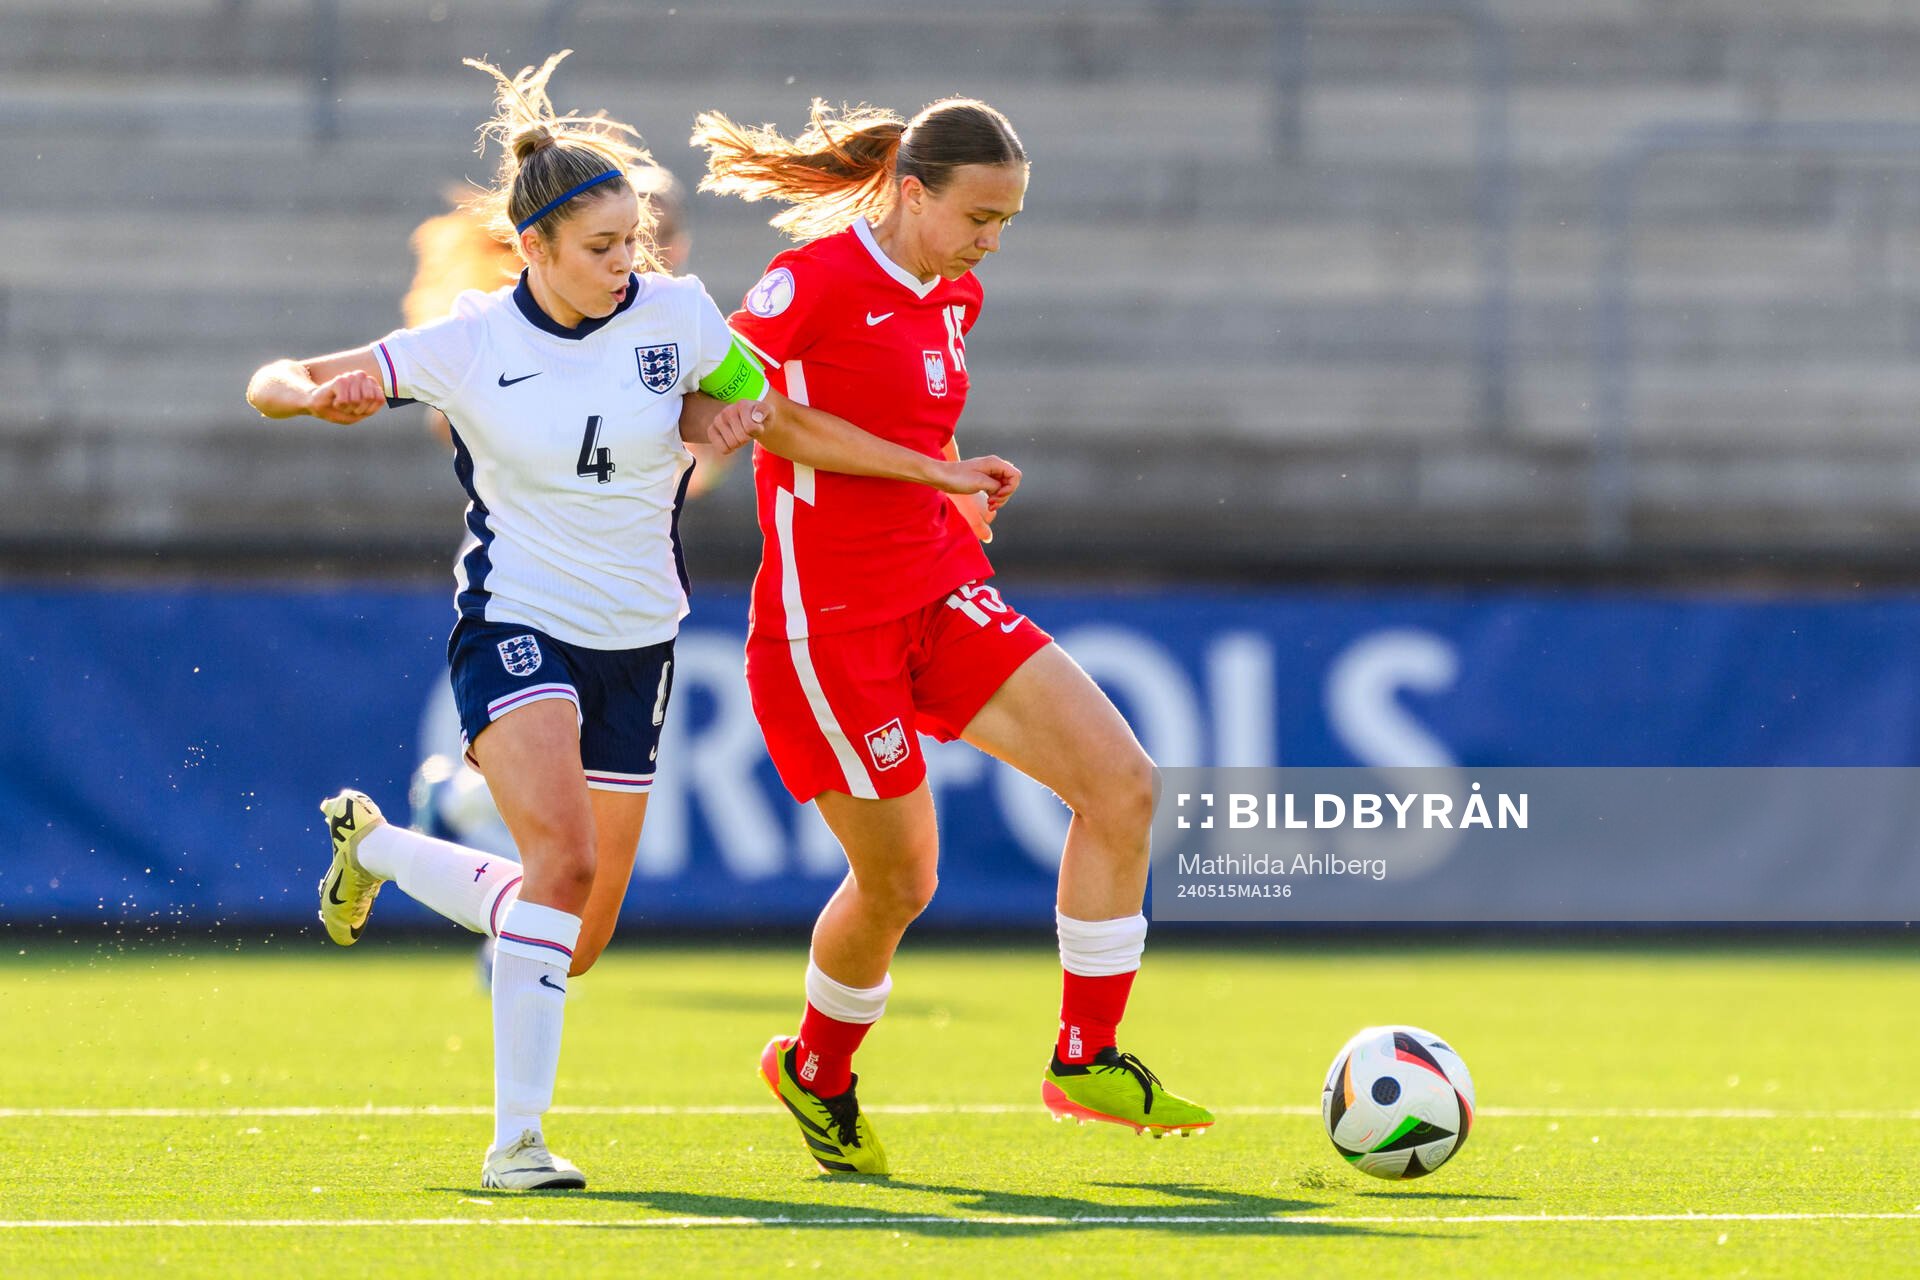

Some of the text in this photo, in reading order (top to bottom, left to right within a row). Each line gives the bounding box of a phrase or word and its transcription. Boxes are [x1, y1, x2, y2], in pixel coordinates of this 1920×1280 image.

[716, 362, 749, 400] RESPECT
[576, 415, 616, 485] 4
[945, 579, 1008, 628] 15
